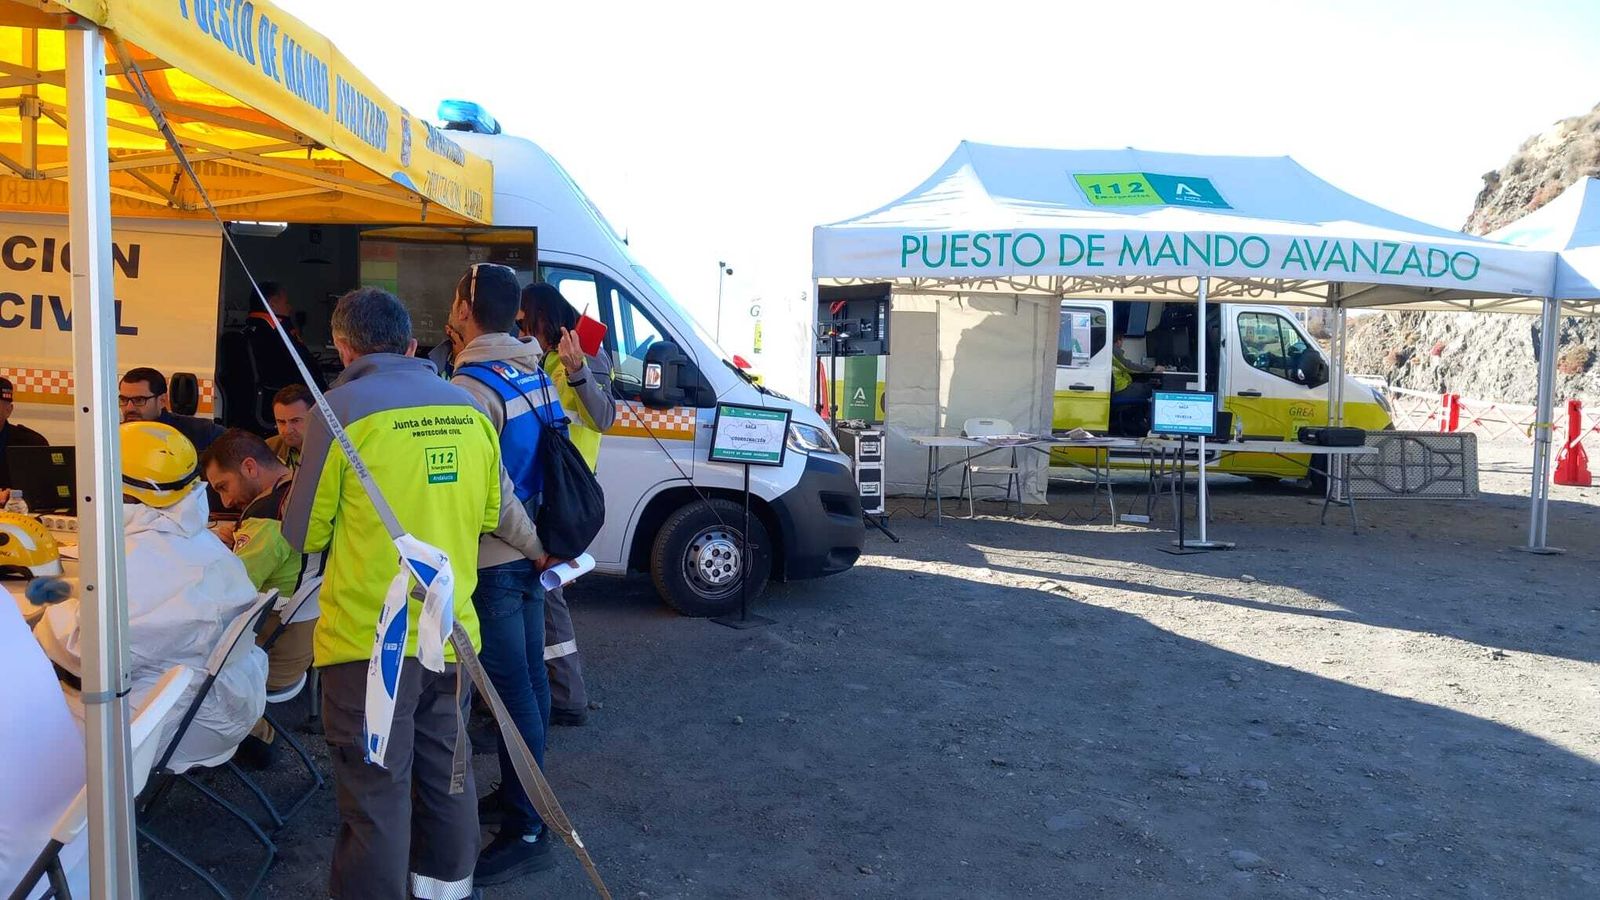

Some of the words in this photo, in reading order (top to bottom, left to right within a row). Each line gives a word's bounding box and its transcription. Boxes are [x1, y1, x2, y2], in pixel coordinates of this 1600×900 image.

[257, 14, 280, 83] DE
[283, 34, 330, 115] MANDO
[336, 75, 388, 152] AVANZADO
[902, 232, 1046, 269] PUESTO
[1058, 233, 1105, 267] DE
[1117, 233, 1271, 269] MANDO
[1281, 239, 1481, 282] AVANZADO
[0, 292, 138, 335] CIVL
[1289, 406, 1315, 417] GREA
[392, 419, 419, 430] Junta
[420, 416, 433, 427] de
[434, 414, 474, 425] Andalucía
[412, 428, 448, 437] PROTECCIÓN
[430, 452, 454, 465] 112
